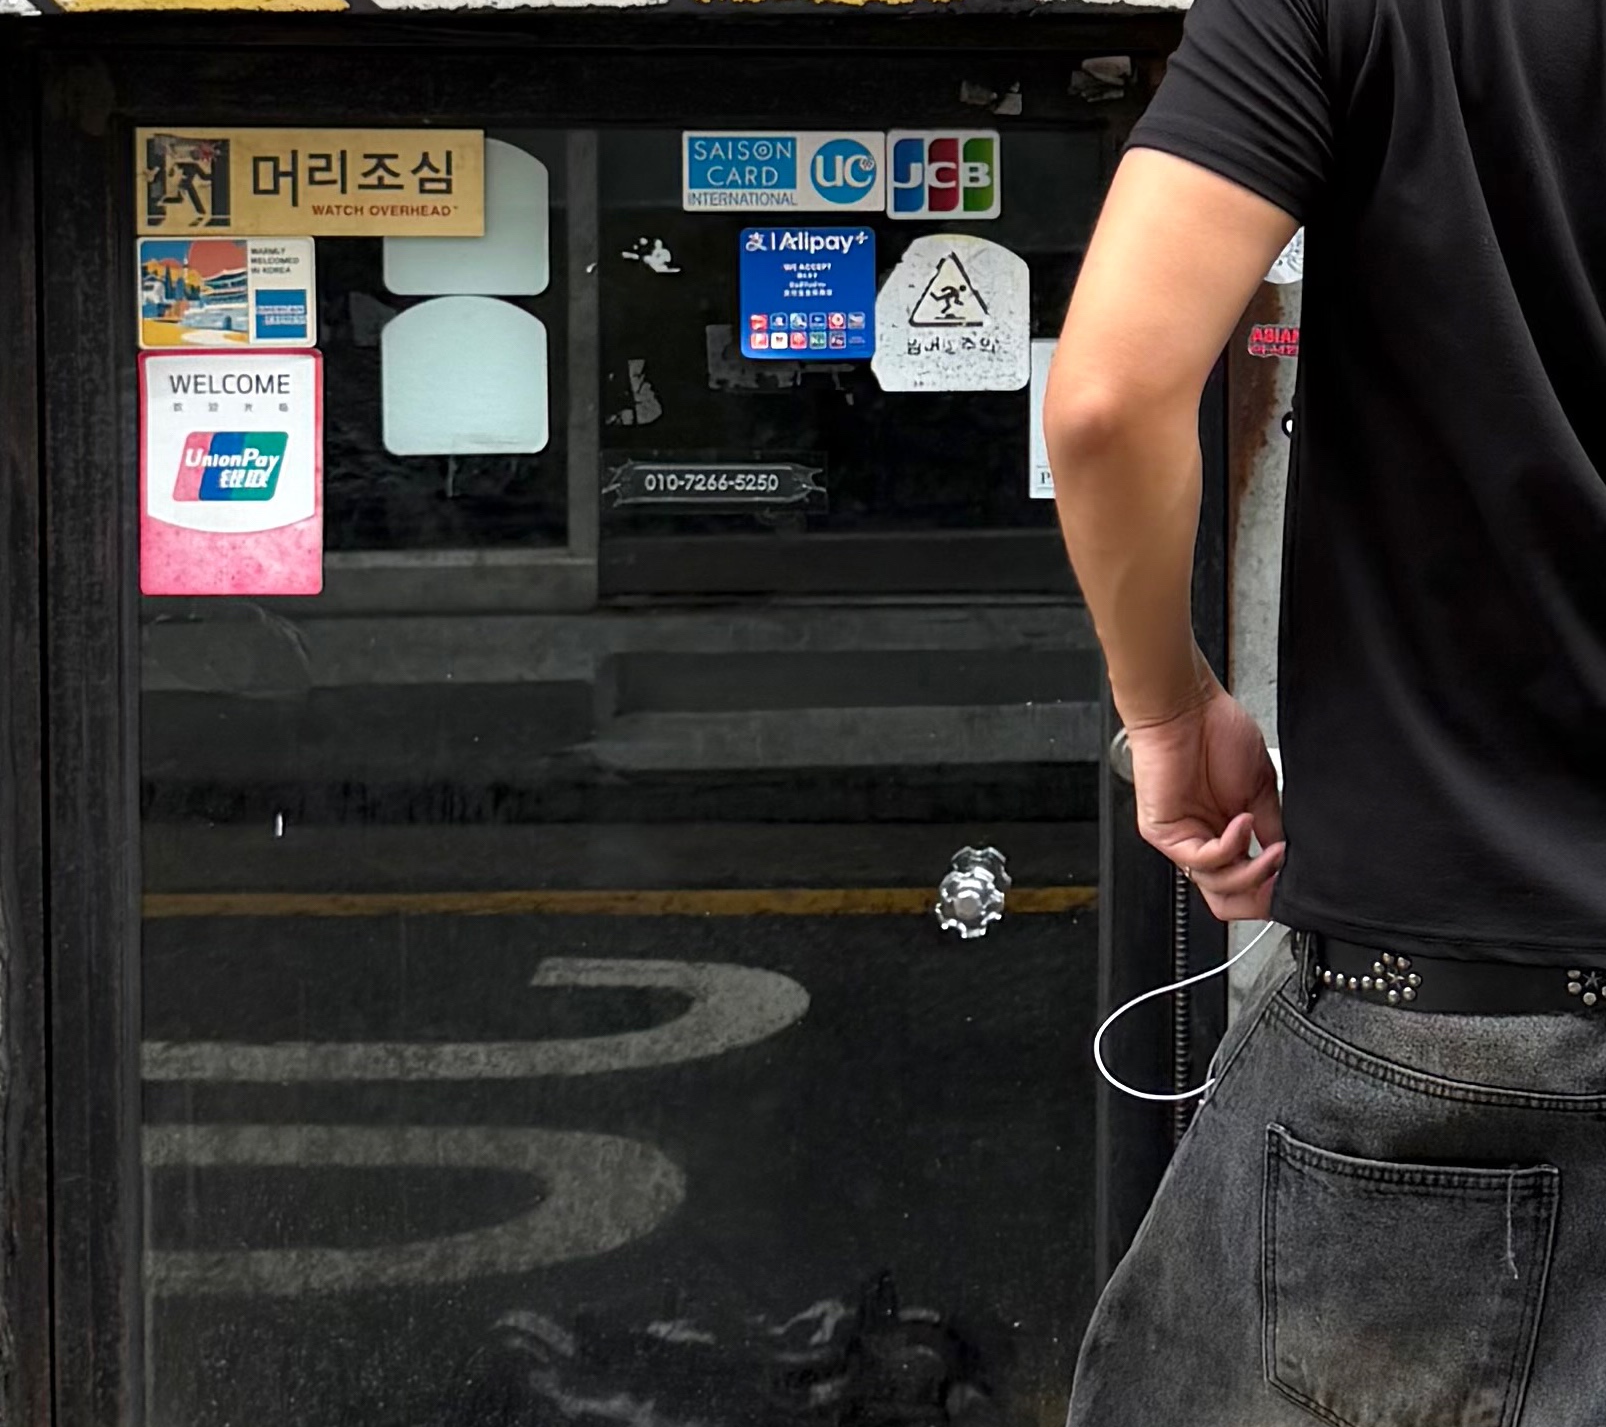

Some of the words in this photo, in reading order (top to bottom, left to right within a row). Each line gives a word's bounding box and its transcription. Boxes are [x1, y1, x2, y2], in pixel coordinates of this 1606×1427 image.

[694, 141, 792, 160] SAISON
[252, 150, 453, 207] 머리조심
[707, 167, 778, 187] CARD
[893, 161, 992, 189] JCB
[688, 193, 797, 207] INTERNATIONAL
[312, 205, 364, 217] WATCH
[370, 205, 452, 217] OVERHEAD
[170, 374, 290, 394] WELCOME
[185, 448, 279, 472] UnionPay
[645, 474, 779, 491] 010-7266-5250
